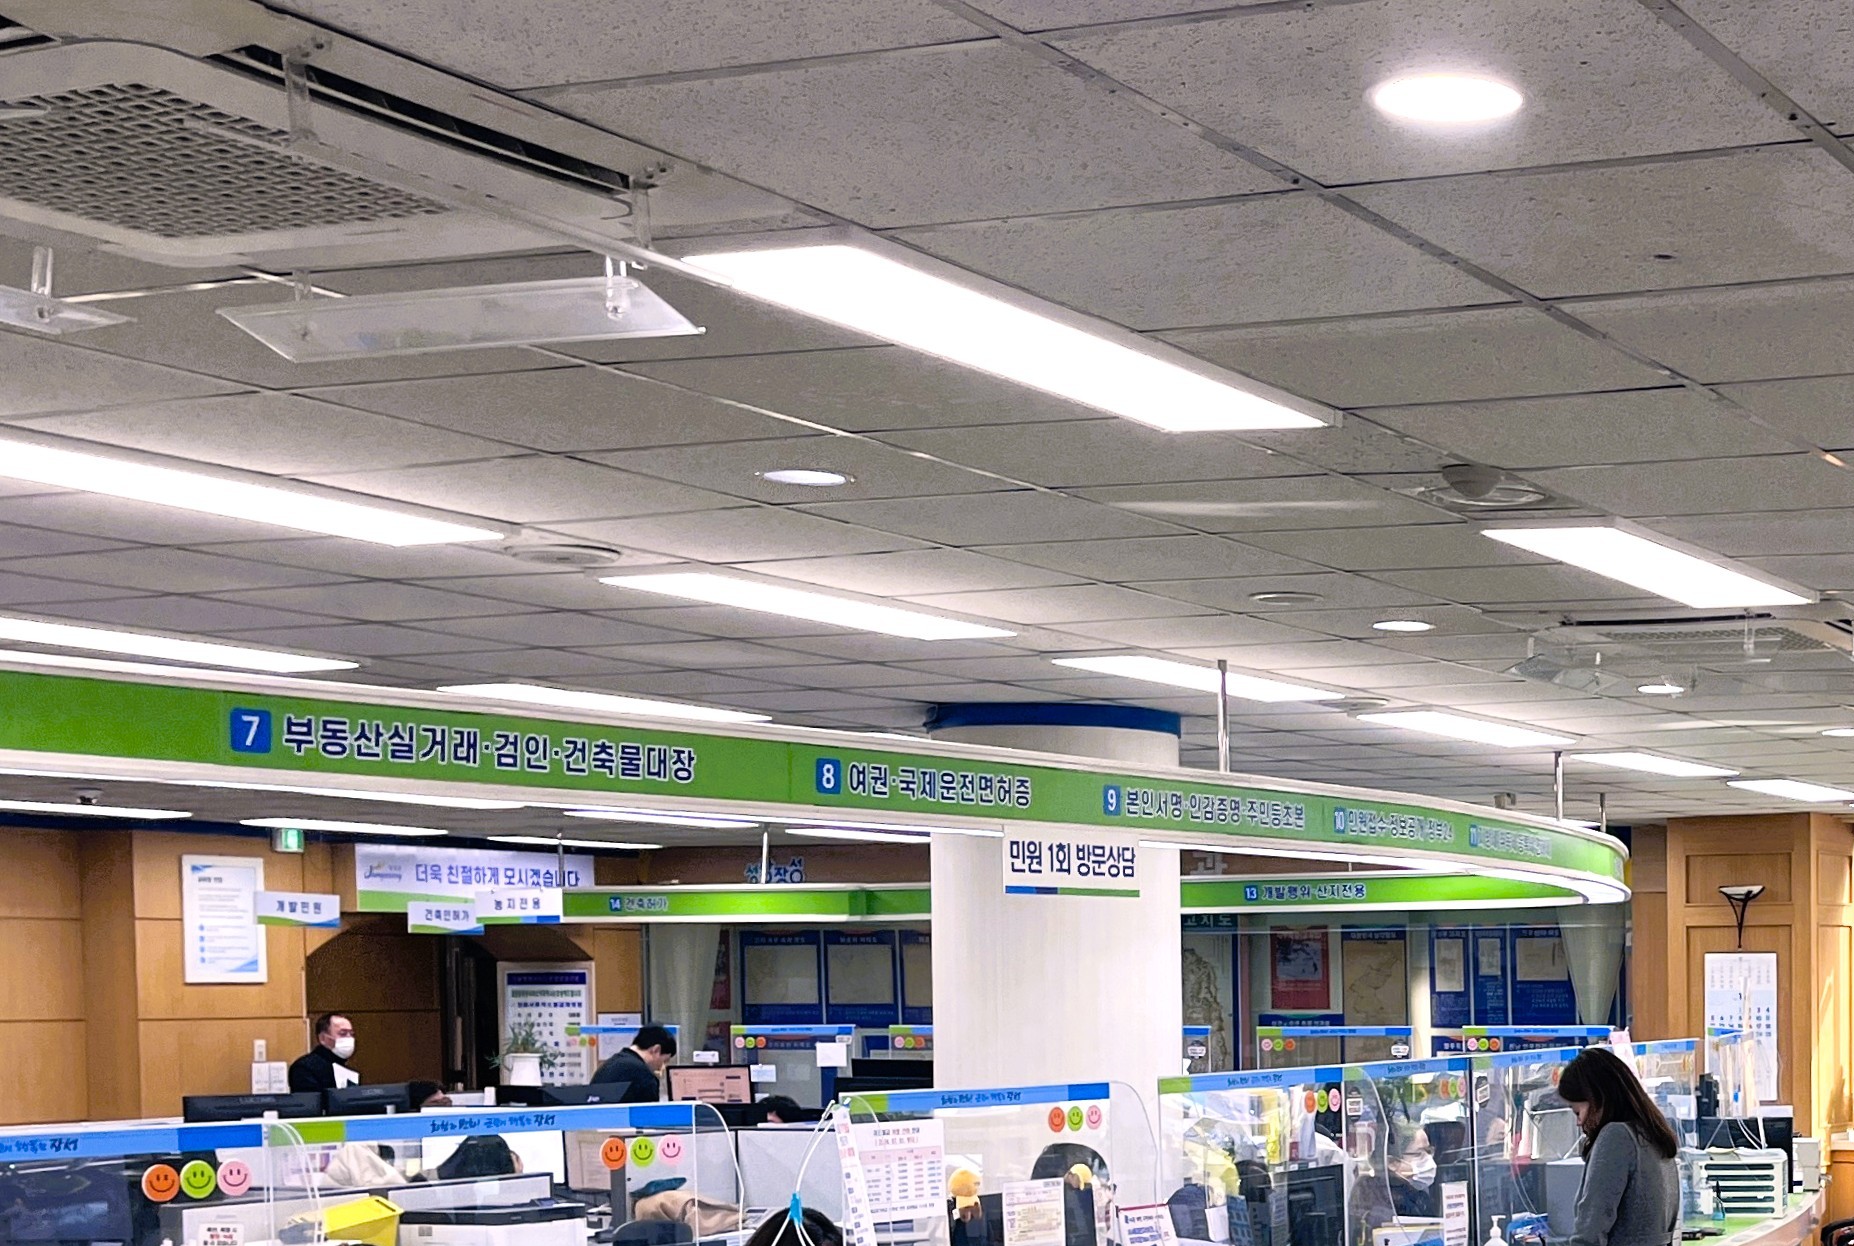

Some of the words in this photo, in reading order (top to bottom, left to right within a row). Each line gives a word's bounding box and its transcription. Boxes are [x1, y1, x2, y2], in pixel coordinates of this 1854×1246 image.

[241, 715, 261, 746] 7
[284, 715, 696, 782] 부동산실거래·검인·건축물대장
[822, 763, 835, 789] 8
[849, 763, 1030, 807] 여권·국제운전면허증
[1107, 789, 1117, 811] 9
[1010, 841, 1043, 874] 민원
[1048, 842, 1071, 875] 1회
[1077, 844, 1136, 878] 방문상담
[415, 864, 442, 885] 더욱
[447, 864, 499, 886] 친절하게
[1246, 887, 1257, 899] 13
[494, 898, 540, 911] 농지전용
